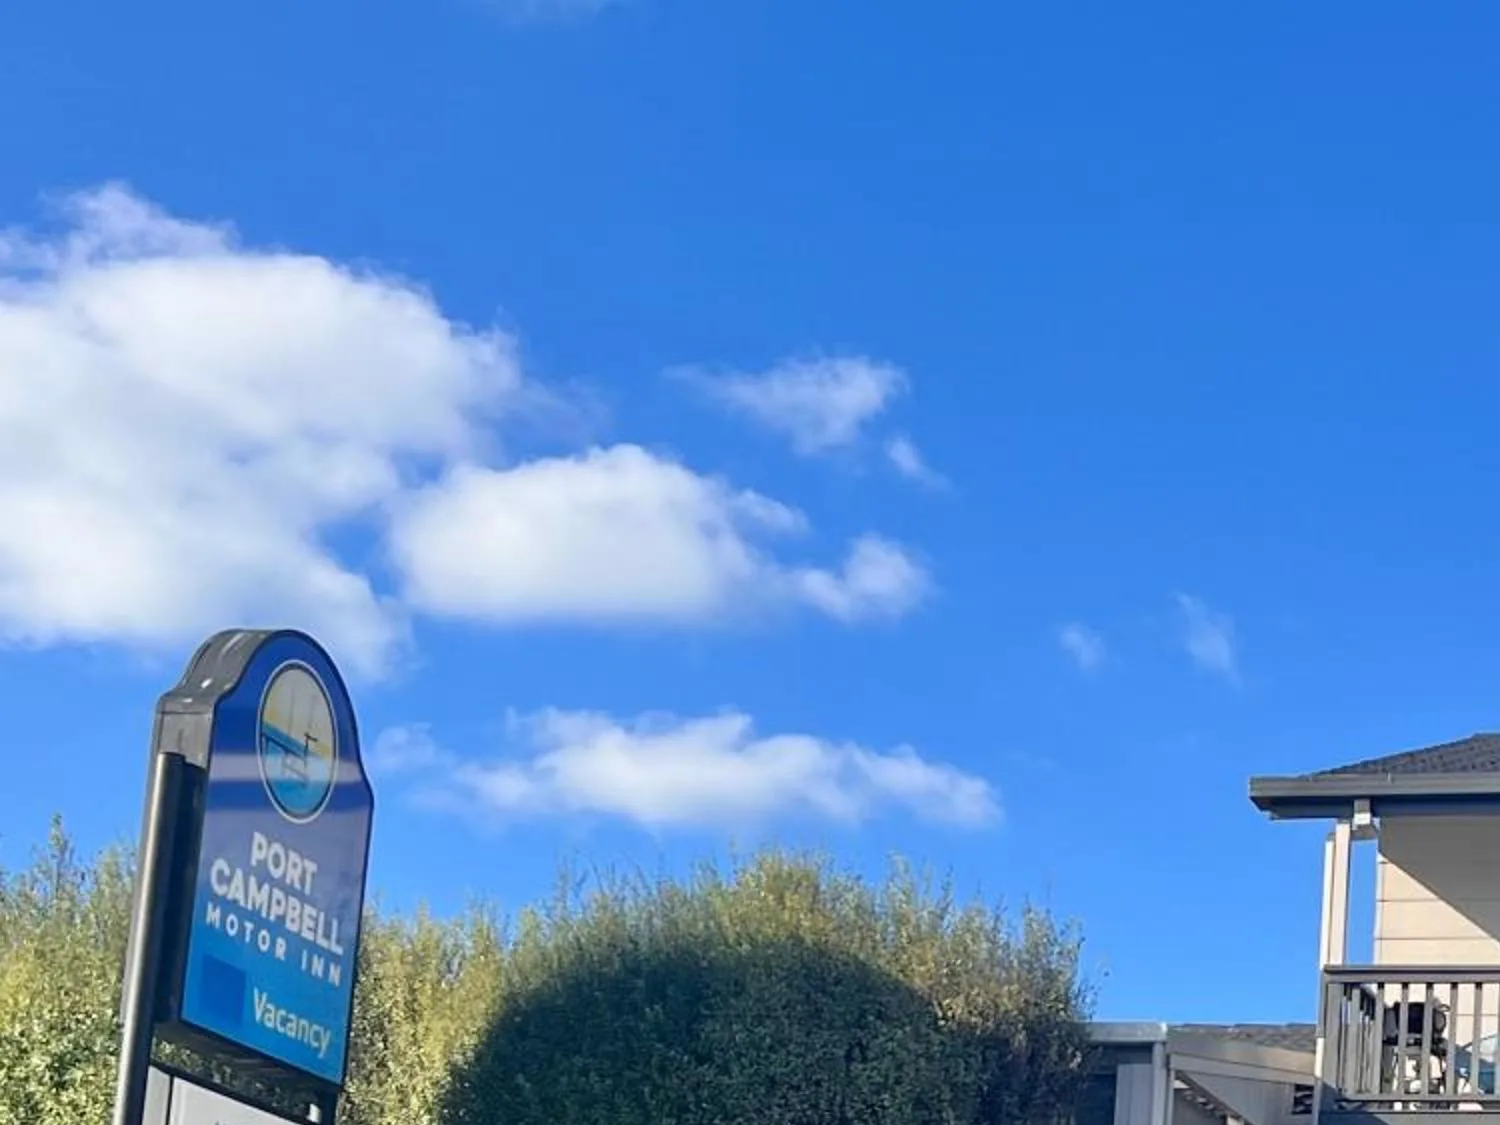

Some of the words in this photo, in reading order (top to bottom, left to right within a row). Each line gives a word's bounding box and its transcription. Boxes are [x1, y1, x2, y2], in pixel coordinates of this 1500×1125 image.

[251, 831, 318, 896] PORT
[206, 901, 286, 961] MOTOR
[301, 950, 342, 987] INN
[210, 857, 344, 956] CAMPBELL
[253, 987, 332, 1059] Vacancy
